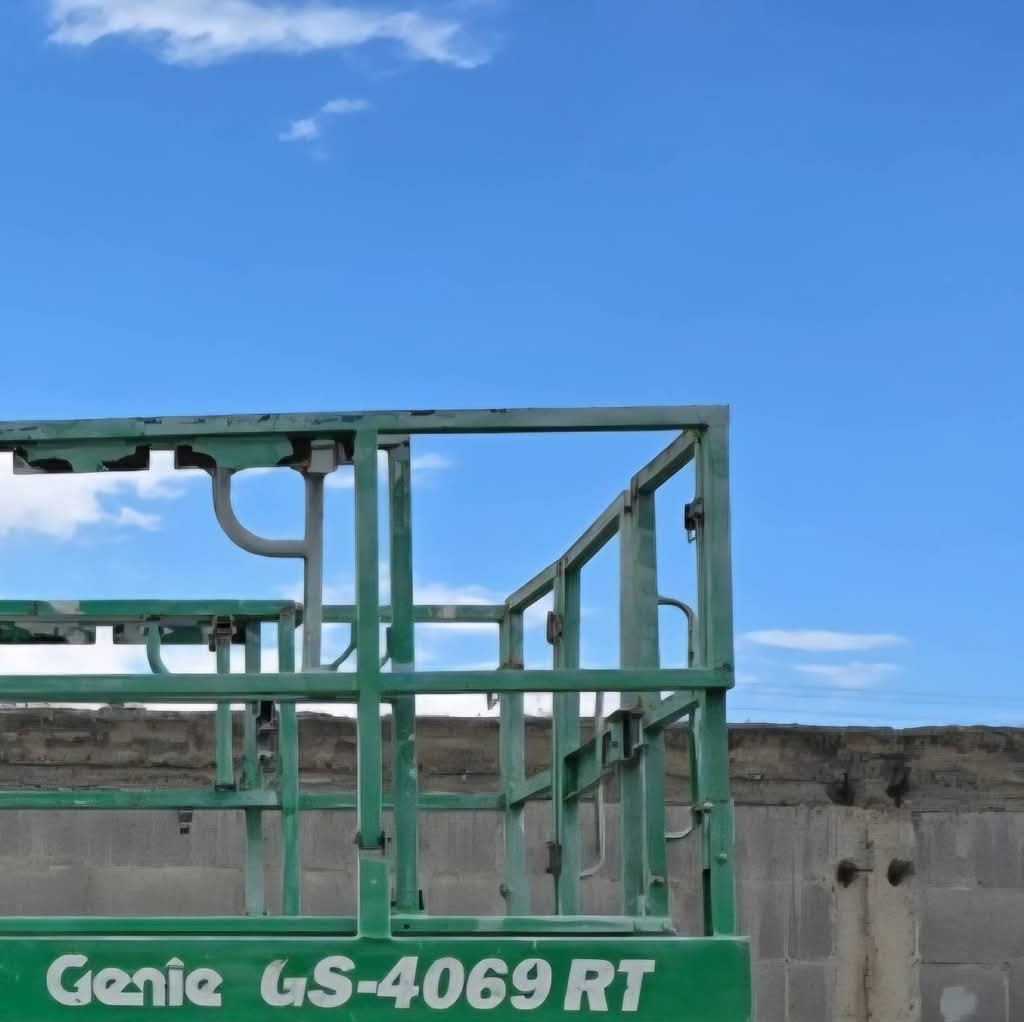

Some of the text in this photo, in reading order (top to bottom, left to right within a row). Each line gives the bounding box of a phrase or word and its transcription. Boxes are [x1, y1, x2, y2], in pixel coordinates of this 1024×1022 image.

[46, 954, 655, 1012] Genie GS-4069 RT
